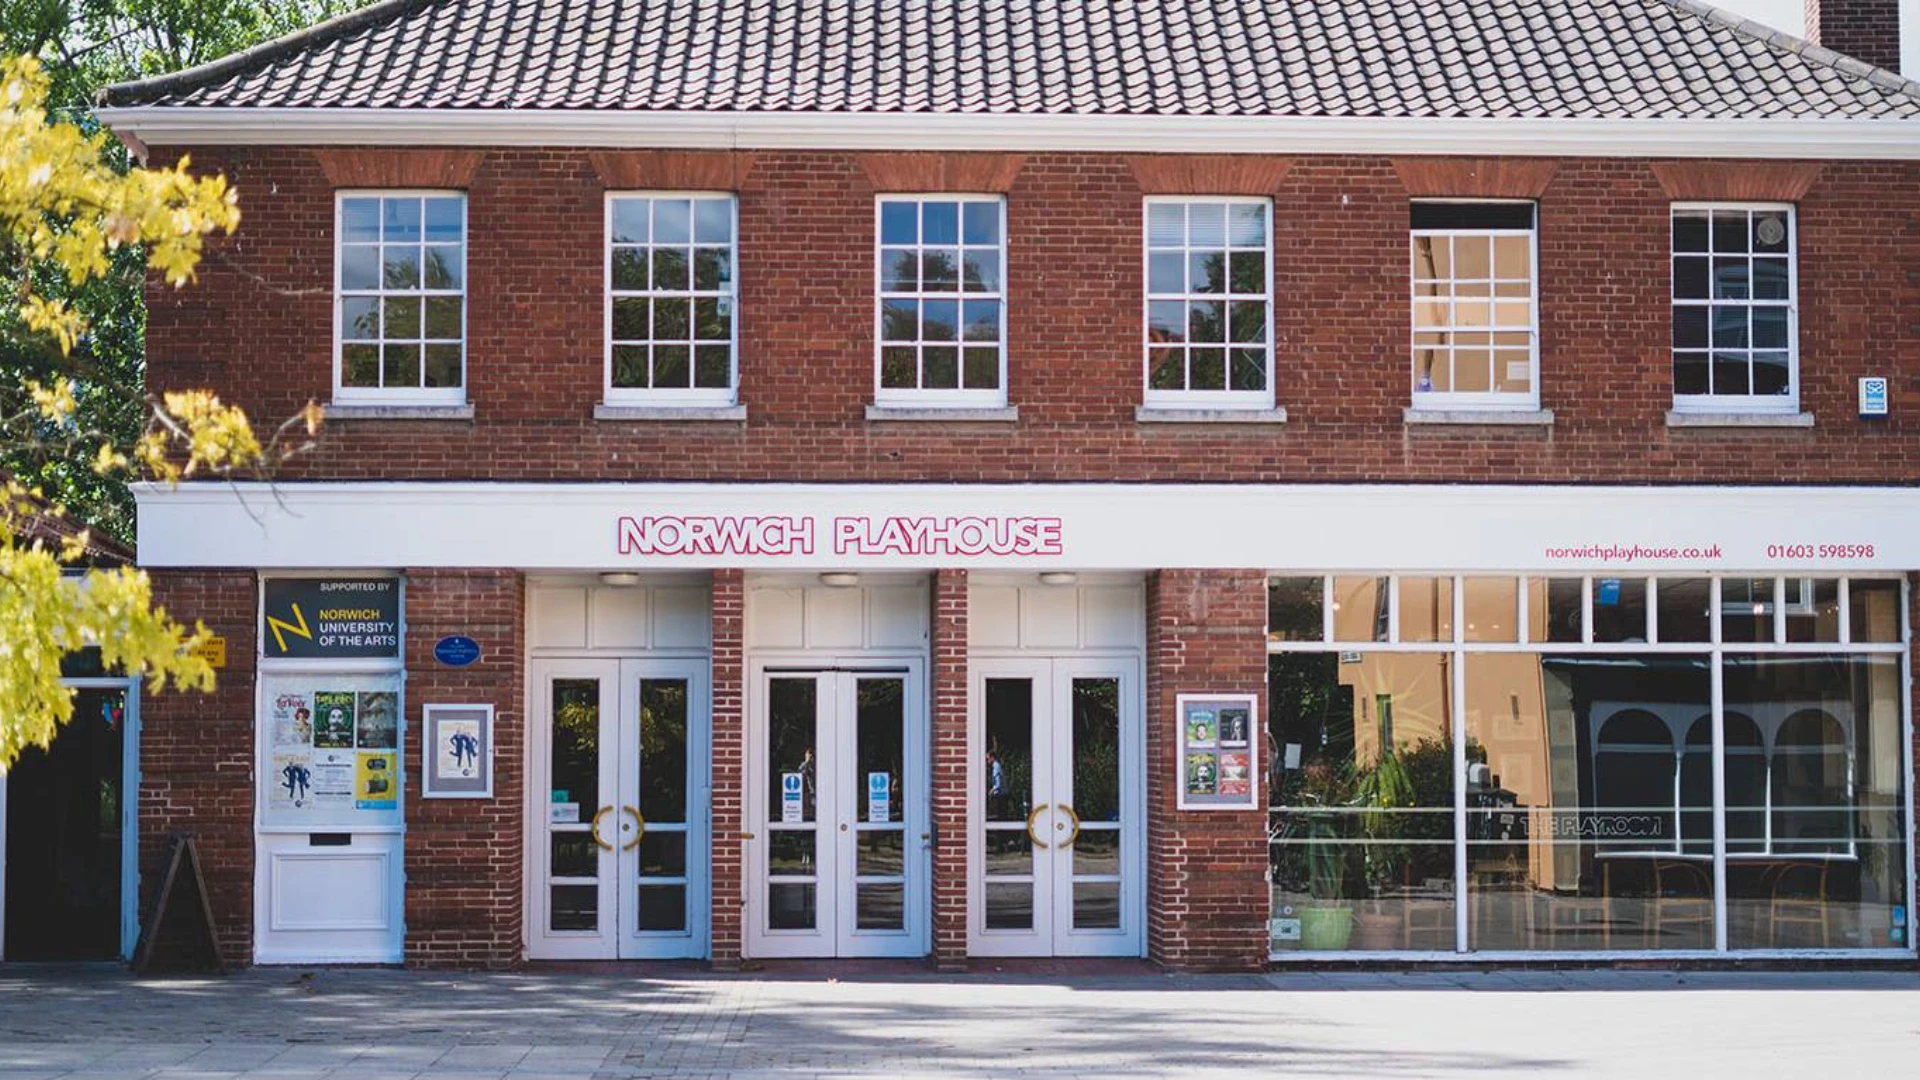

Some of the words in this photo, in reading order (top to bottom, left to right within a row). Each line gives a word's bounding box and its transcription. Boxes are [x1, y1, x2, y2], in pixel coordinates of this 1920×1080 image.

[618, 516, 814, 554] NORWICH
[834, 516, 1063, 554] PLAYHOUSE
[1545, 543, 1722, 561] norwichplayhouse.co.uk
[1767, 544, 1814, 559] 01603
[1818, 544, 1875, 559] 598598
[319, 582, 376, 592] SUPPORTED
[377, 582, 390, 592] BY
[319, 609, 380, 620] NORWICH
[319, 622, 395, 633] UNIVERSITY
[319, 635, 336, 647] OF
[338, 635, 362, 647] THE
[364, 635, 397, 647] ARTS
[1519, 816, 1559, 836] THE
[1561, 816, 1662, 836] PLAYROOM
